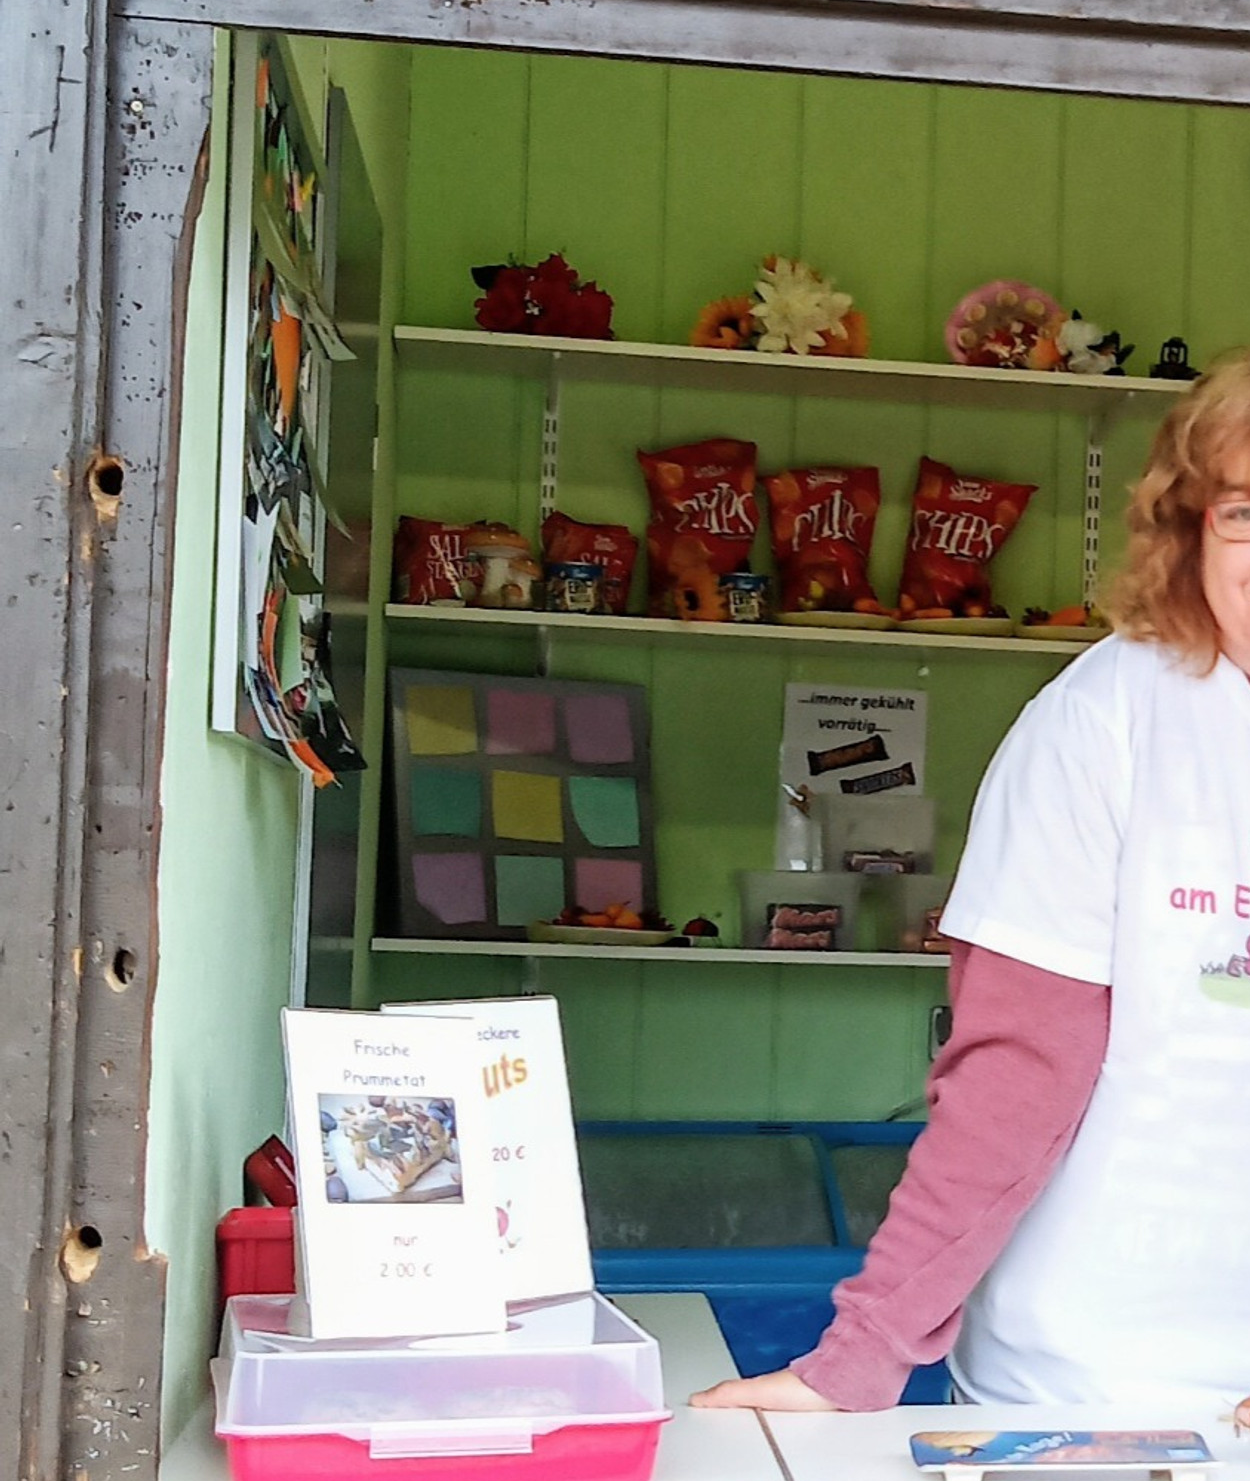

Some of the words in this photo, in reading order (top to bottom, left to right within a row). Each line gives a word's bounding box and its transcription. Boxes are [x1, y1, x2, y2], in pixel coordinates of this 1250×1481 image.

[860, 695, 915, 710] gekühlt
[1170, 887, 1217, 914] am
[353, 1038, 411, 1057] Frische
[515, 1145, 526, 1160] €
[393, 1235, 418, 1247] nur
